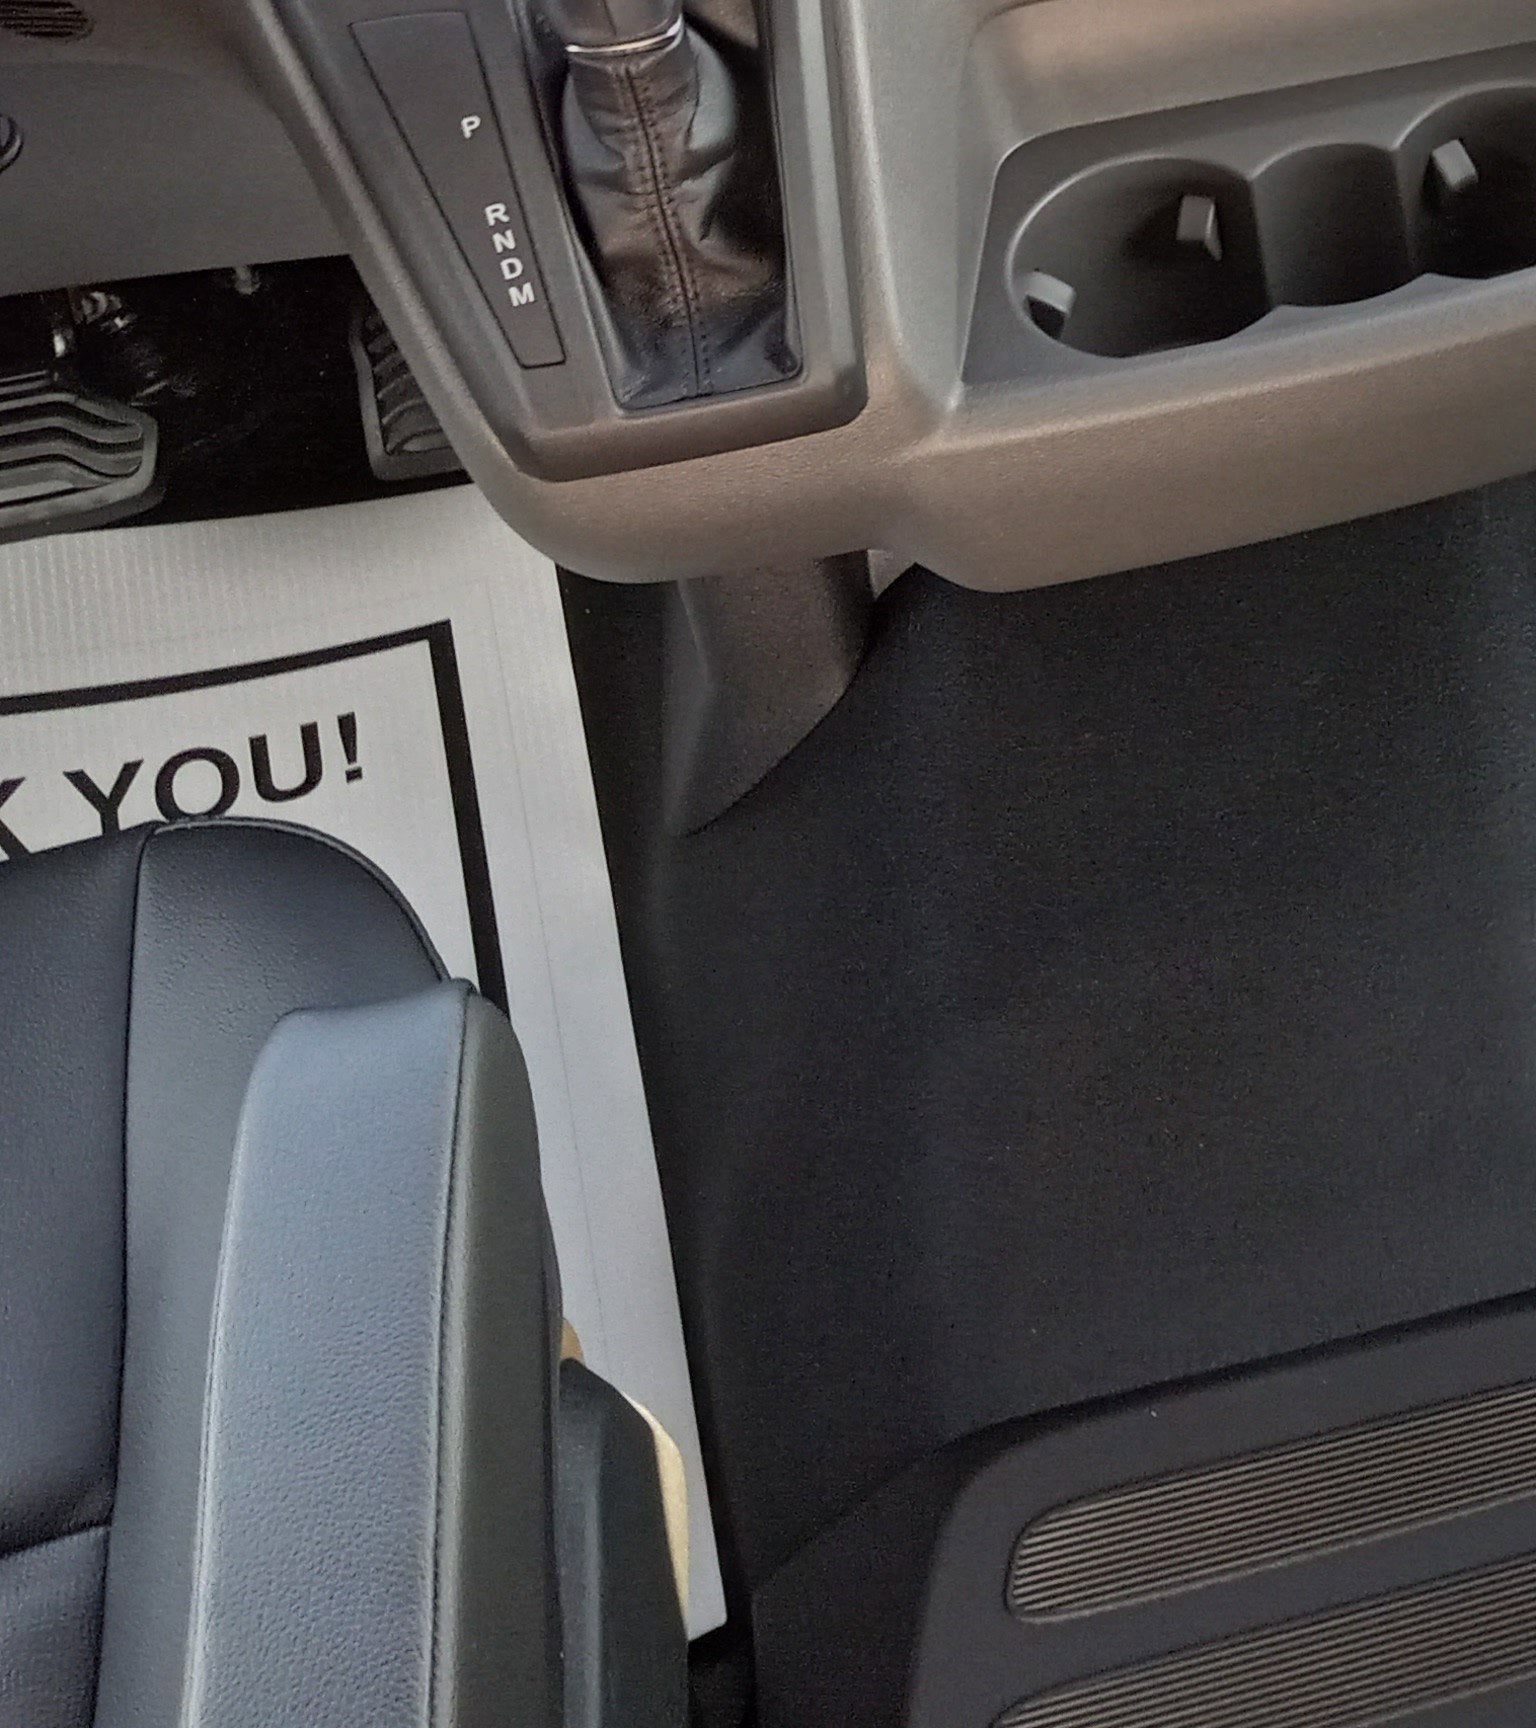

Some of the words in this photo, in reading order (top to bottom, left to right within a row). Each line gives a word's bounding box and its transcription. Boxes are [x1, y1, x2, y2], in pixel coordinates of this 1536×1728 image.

[460, 115, 481, 139] P
[484, 202, 510, 226] R
[492, 229, 516, 253] N
[500, 257, 524, 280] D
[508, 282, 535, 307] M
[63, 711, 364, 834] YOU!
